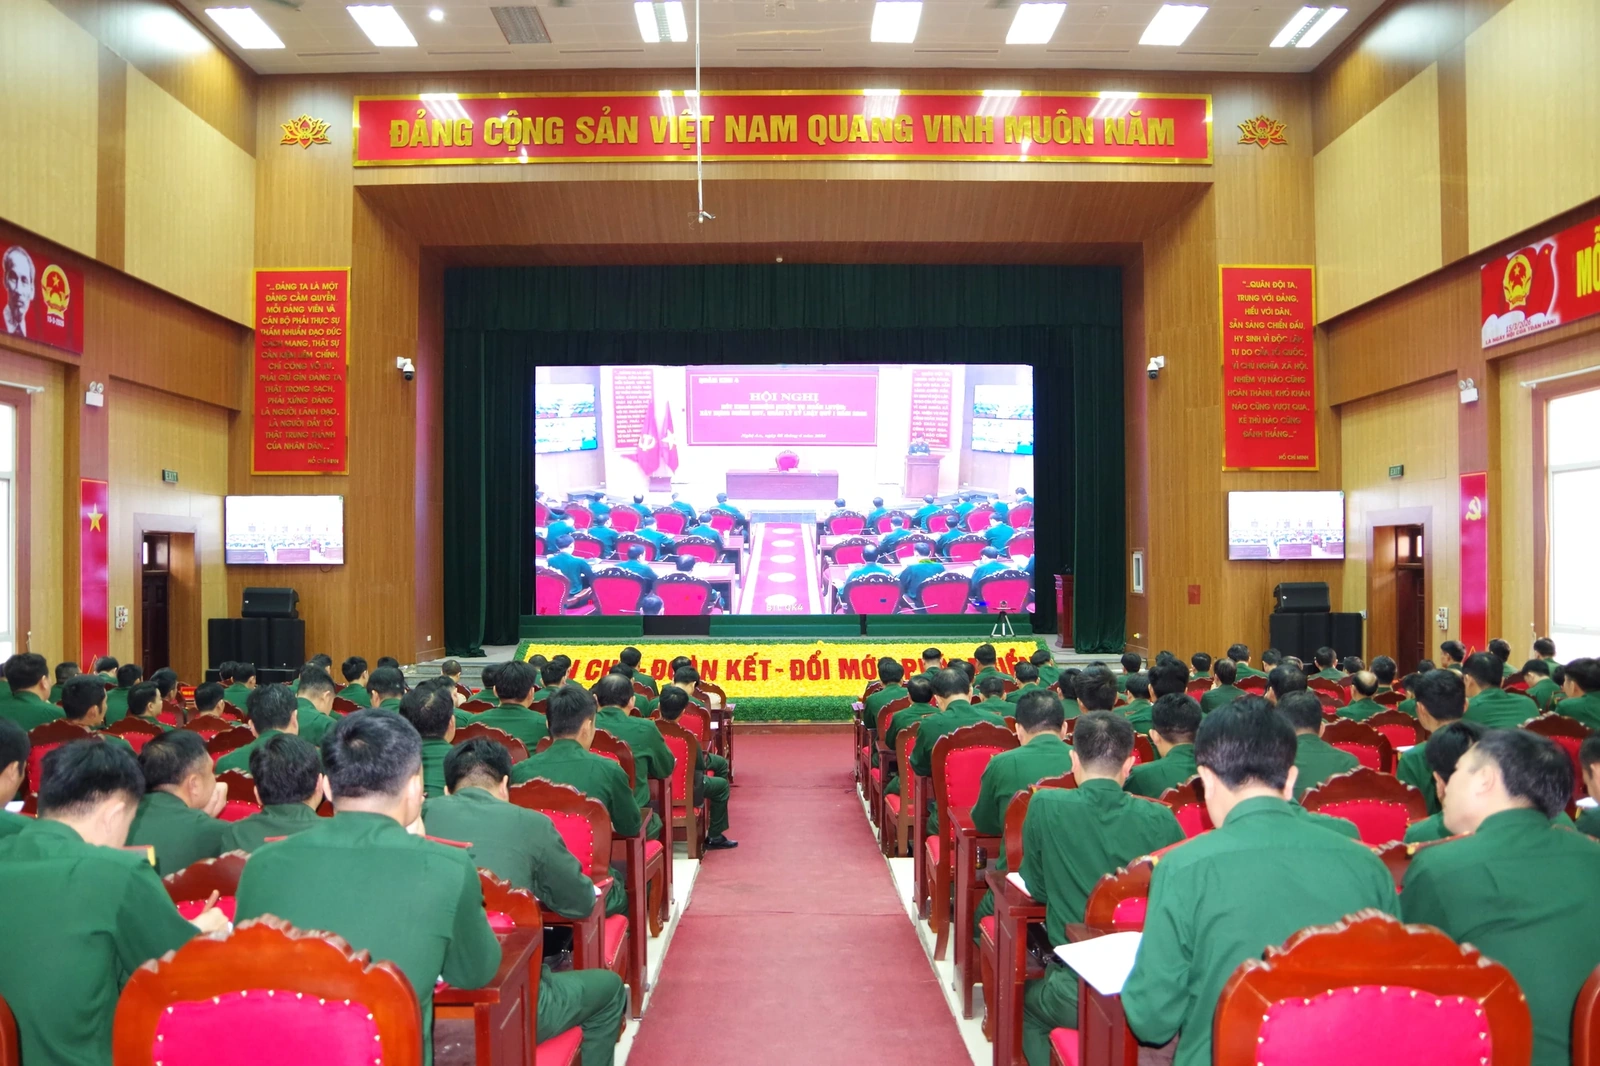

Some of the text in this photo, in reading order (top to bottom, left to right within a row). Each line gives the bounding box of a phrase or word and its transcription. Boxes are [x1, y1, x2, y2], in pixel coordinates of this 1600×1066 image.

[389, 105, 1174, 151] ĐẢNG CỘNG SẢN VIỆT NAM QUANG VINH MUÔN NĂM
[310, 281, 320, 290] LÀ
[322, 281, 338, 291] MỘT
[1272, 280, 1285, 290] ĐỘI
[266, 292, 288, 302] ĐẢNG
[1237, 294, 1260, 302] TRUNG
[1262, 293, 1274, 302] VỚI
[283, 304, 304, 313] ĐẢNG
[308, 304, 324, 313] VIÊN
[1245, 306, 1258, 315] HIẾU
[1261, 307, 1273, 315] VỚI
[280, 316, 290, 326] BỘ
[292, 314, 309, 324] PHẢI
[1245, 320, 1264, 328] SÀNG
[308, 329, 324, 338] ĐẠO
[326, 327, 342, 335] ĐỨC
[1241, 348, 1252, 356] DO
[749, 390, 819, 403] HỘI NGHỊ
[165, 471, 177, 480] EXIT
[1390, 466, 1400, 476] EXIT
[785, 604, 803, 612] QK4
[584, 659, 621, 681] CH
[650, 655, 718, 681] ĐN
[726, 652, 771, 681] KẾT
[789, 650, 830, 681] ĐỔI
[838, 654, 880, 681] MỚ
